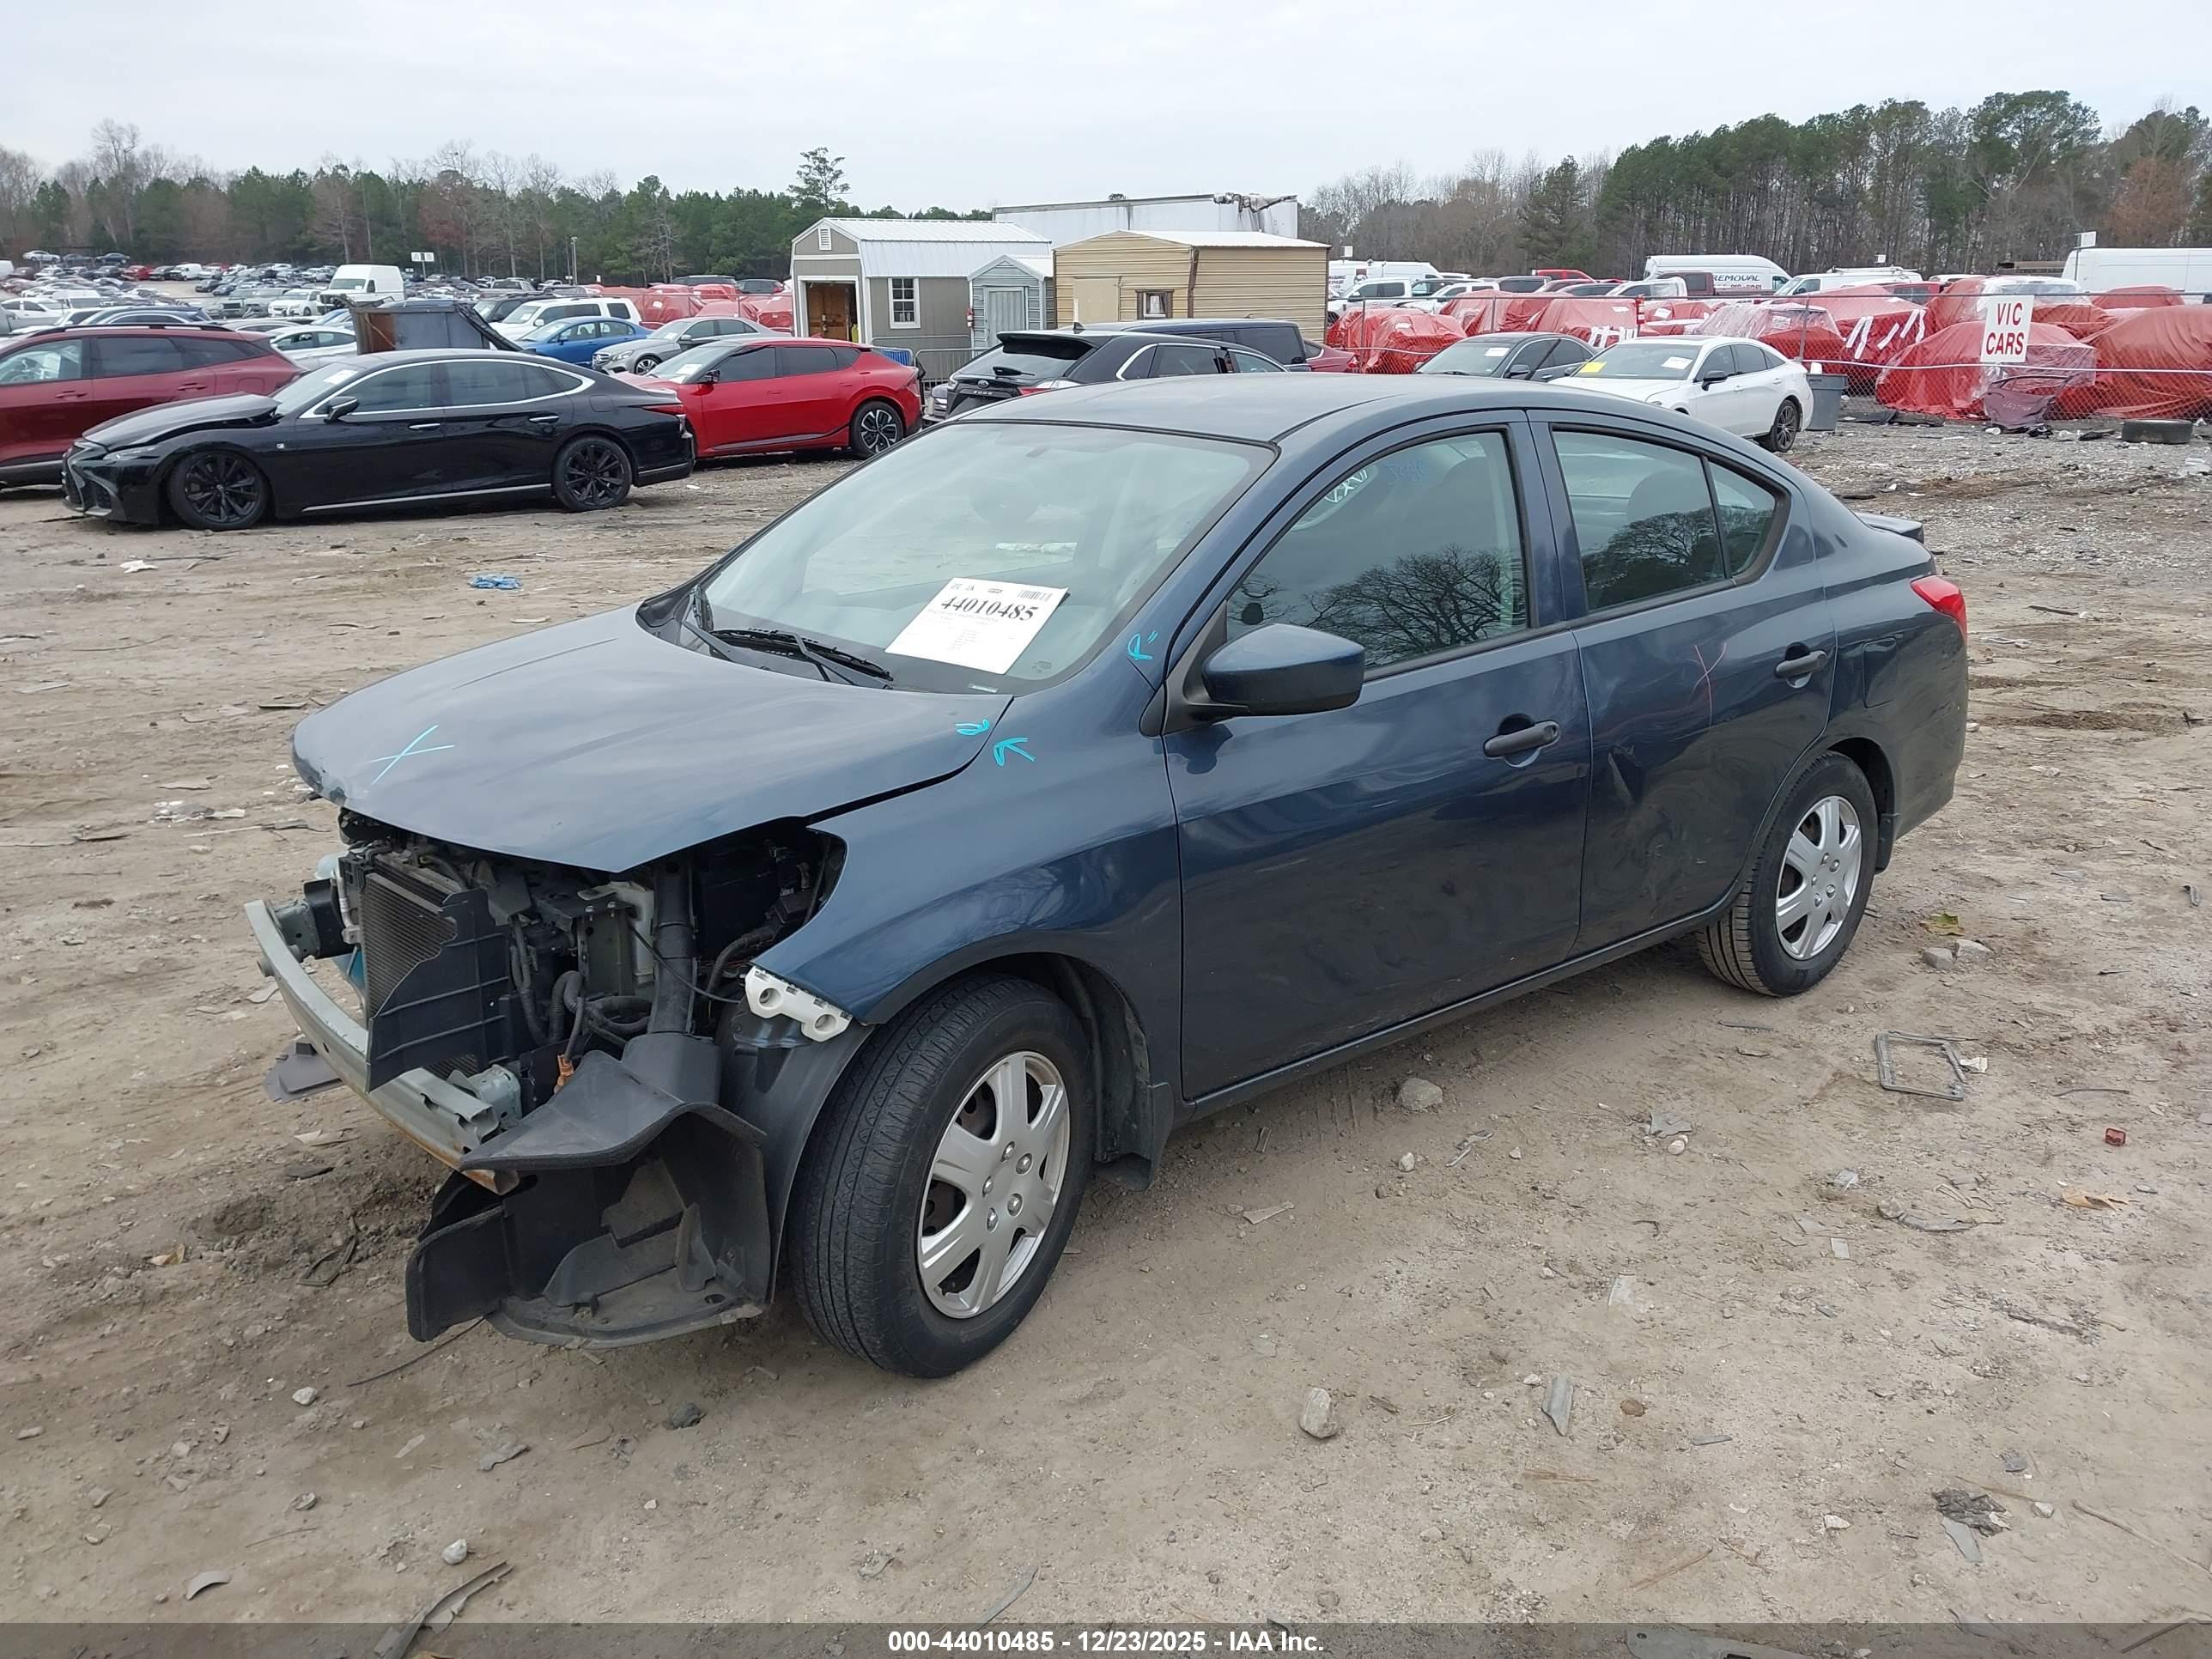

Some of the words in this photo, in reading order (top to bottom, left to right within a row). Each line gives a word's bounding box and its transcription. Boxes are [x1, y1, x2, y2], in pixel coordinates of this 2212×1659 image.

[1997, 302, 2023, 325] VIC
[1985, 331, 2025, 356] CARS
[941, 596, 1038, 621] 44010485
